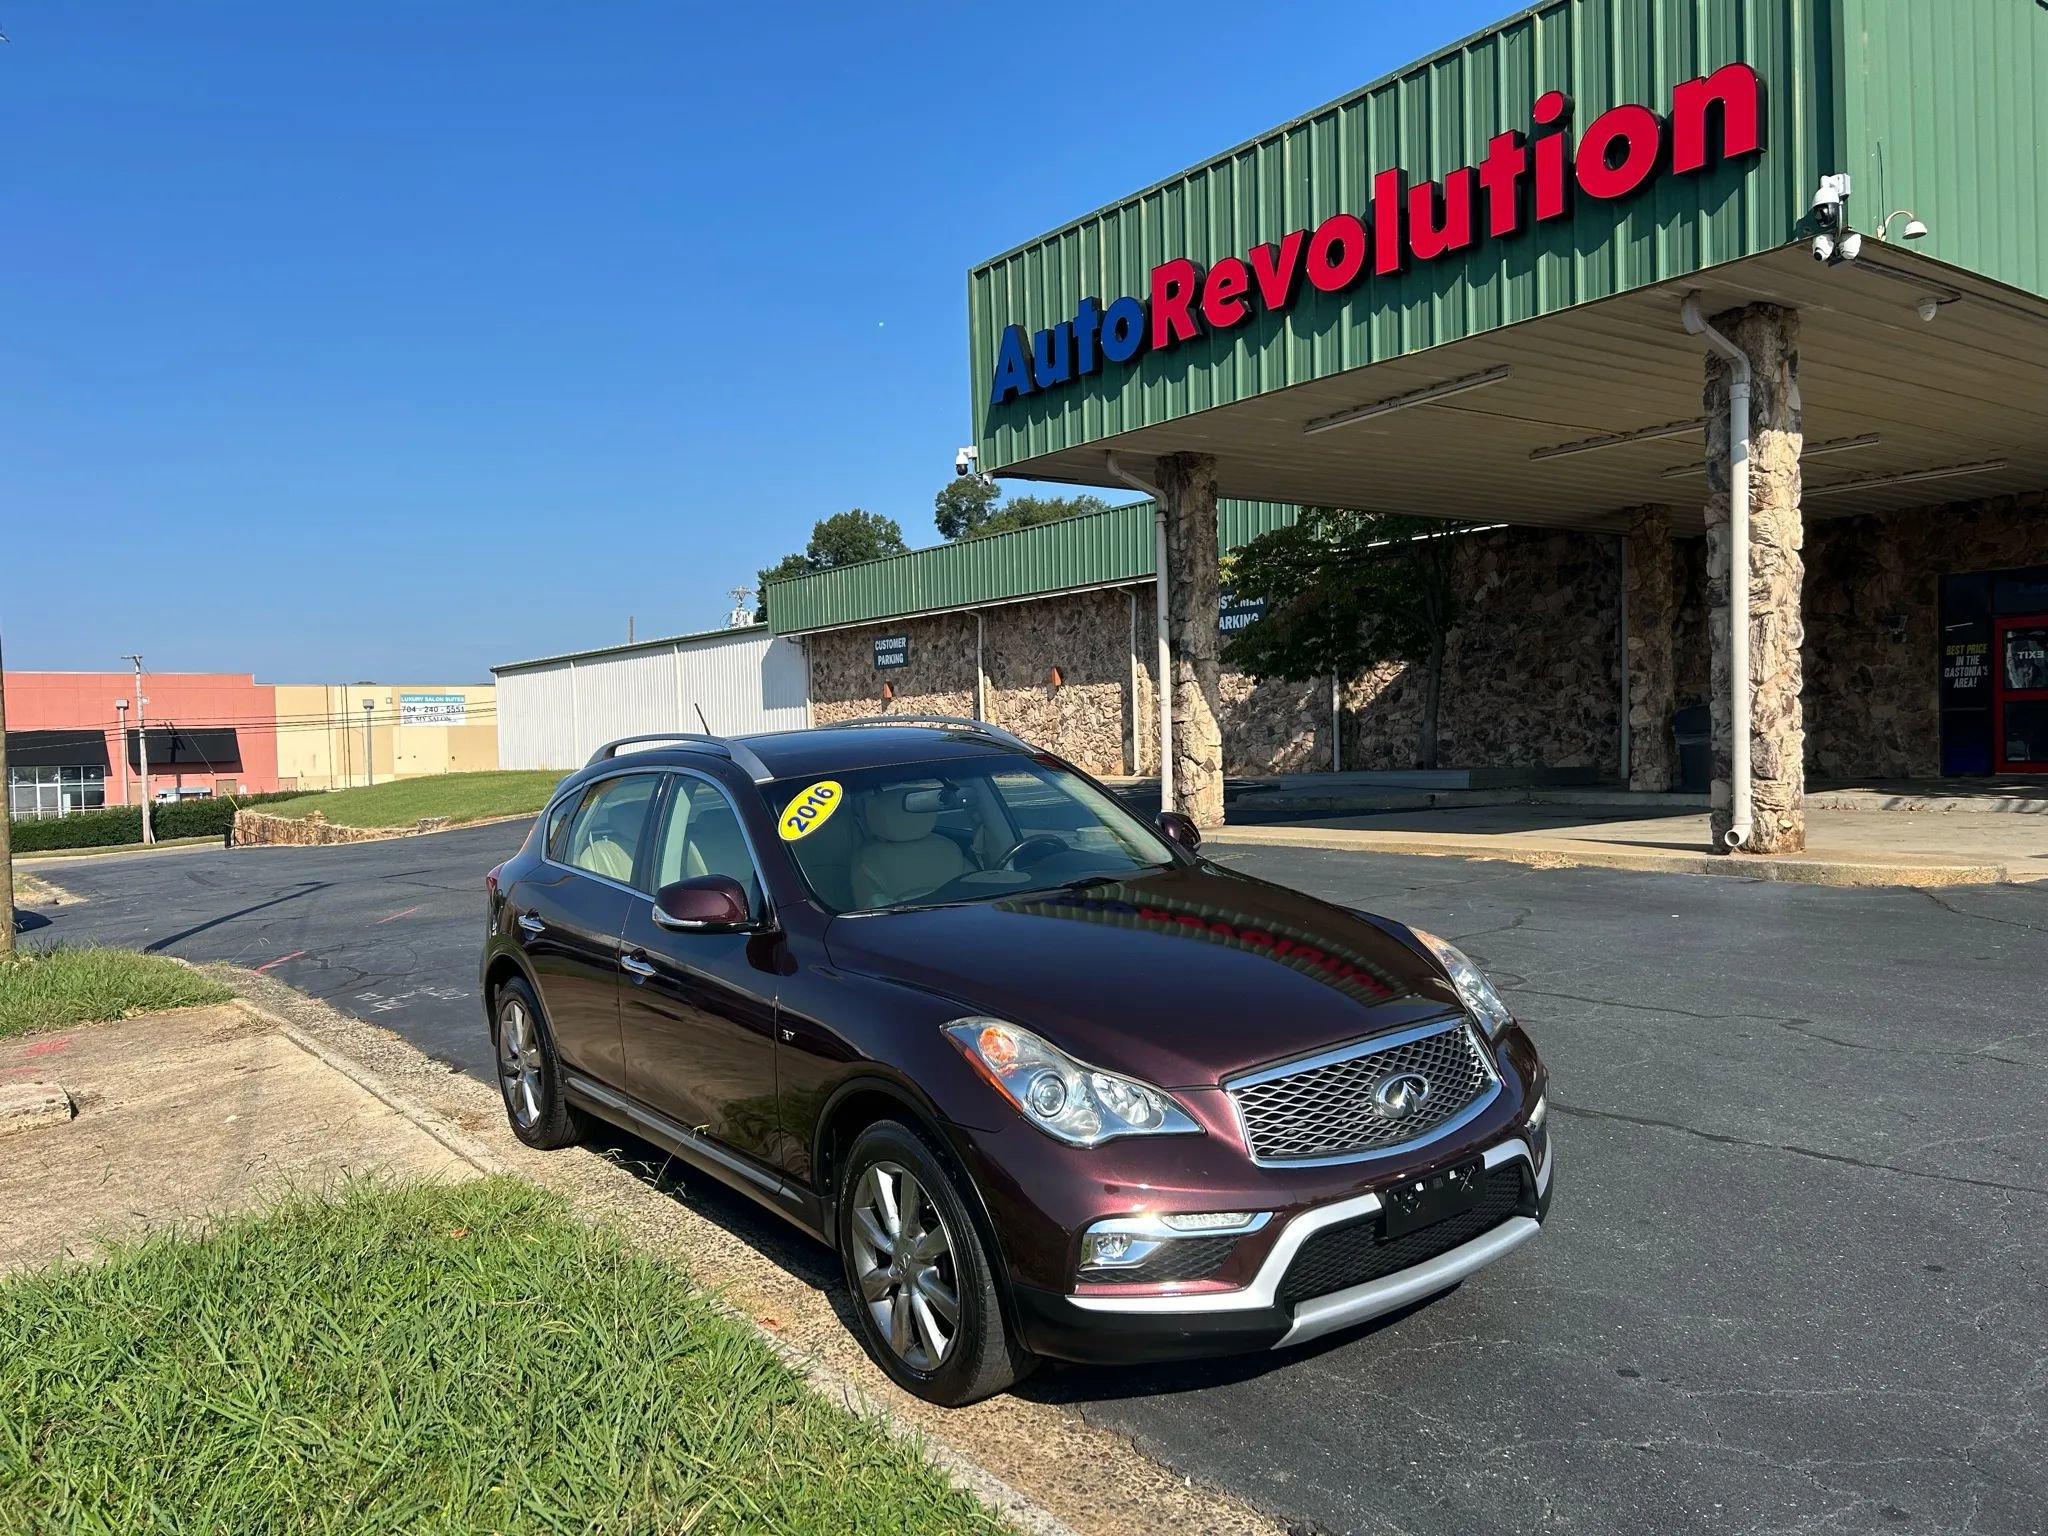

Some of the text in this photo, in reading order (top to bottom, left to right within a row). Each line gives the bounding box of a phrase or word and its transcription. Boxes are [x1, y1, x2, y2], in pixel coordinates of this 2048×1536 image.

[991, 62, 1766, 404] AutoRevolution
[1218, 612, 1260, 630] ARKING
[875, 637, 907, 650] CUSTOMER
[1946, 643, 1988, 656] BEST PRICE
[877, 653, 904, 666] PARKING
[1955, 655, 1981, 666] IN THE
[1953, 677, 1978, 689] AREA!
[787, 786, 835, 833] 2016
